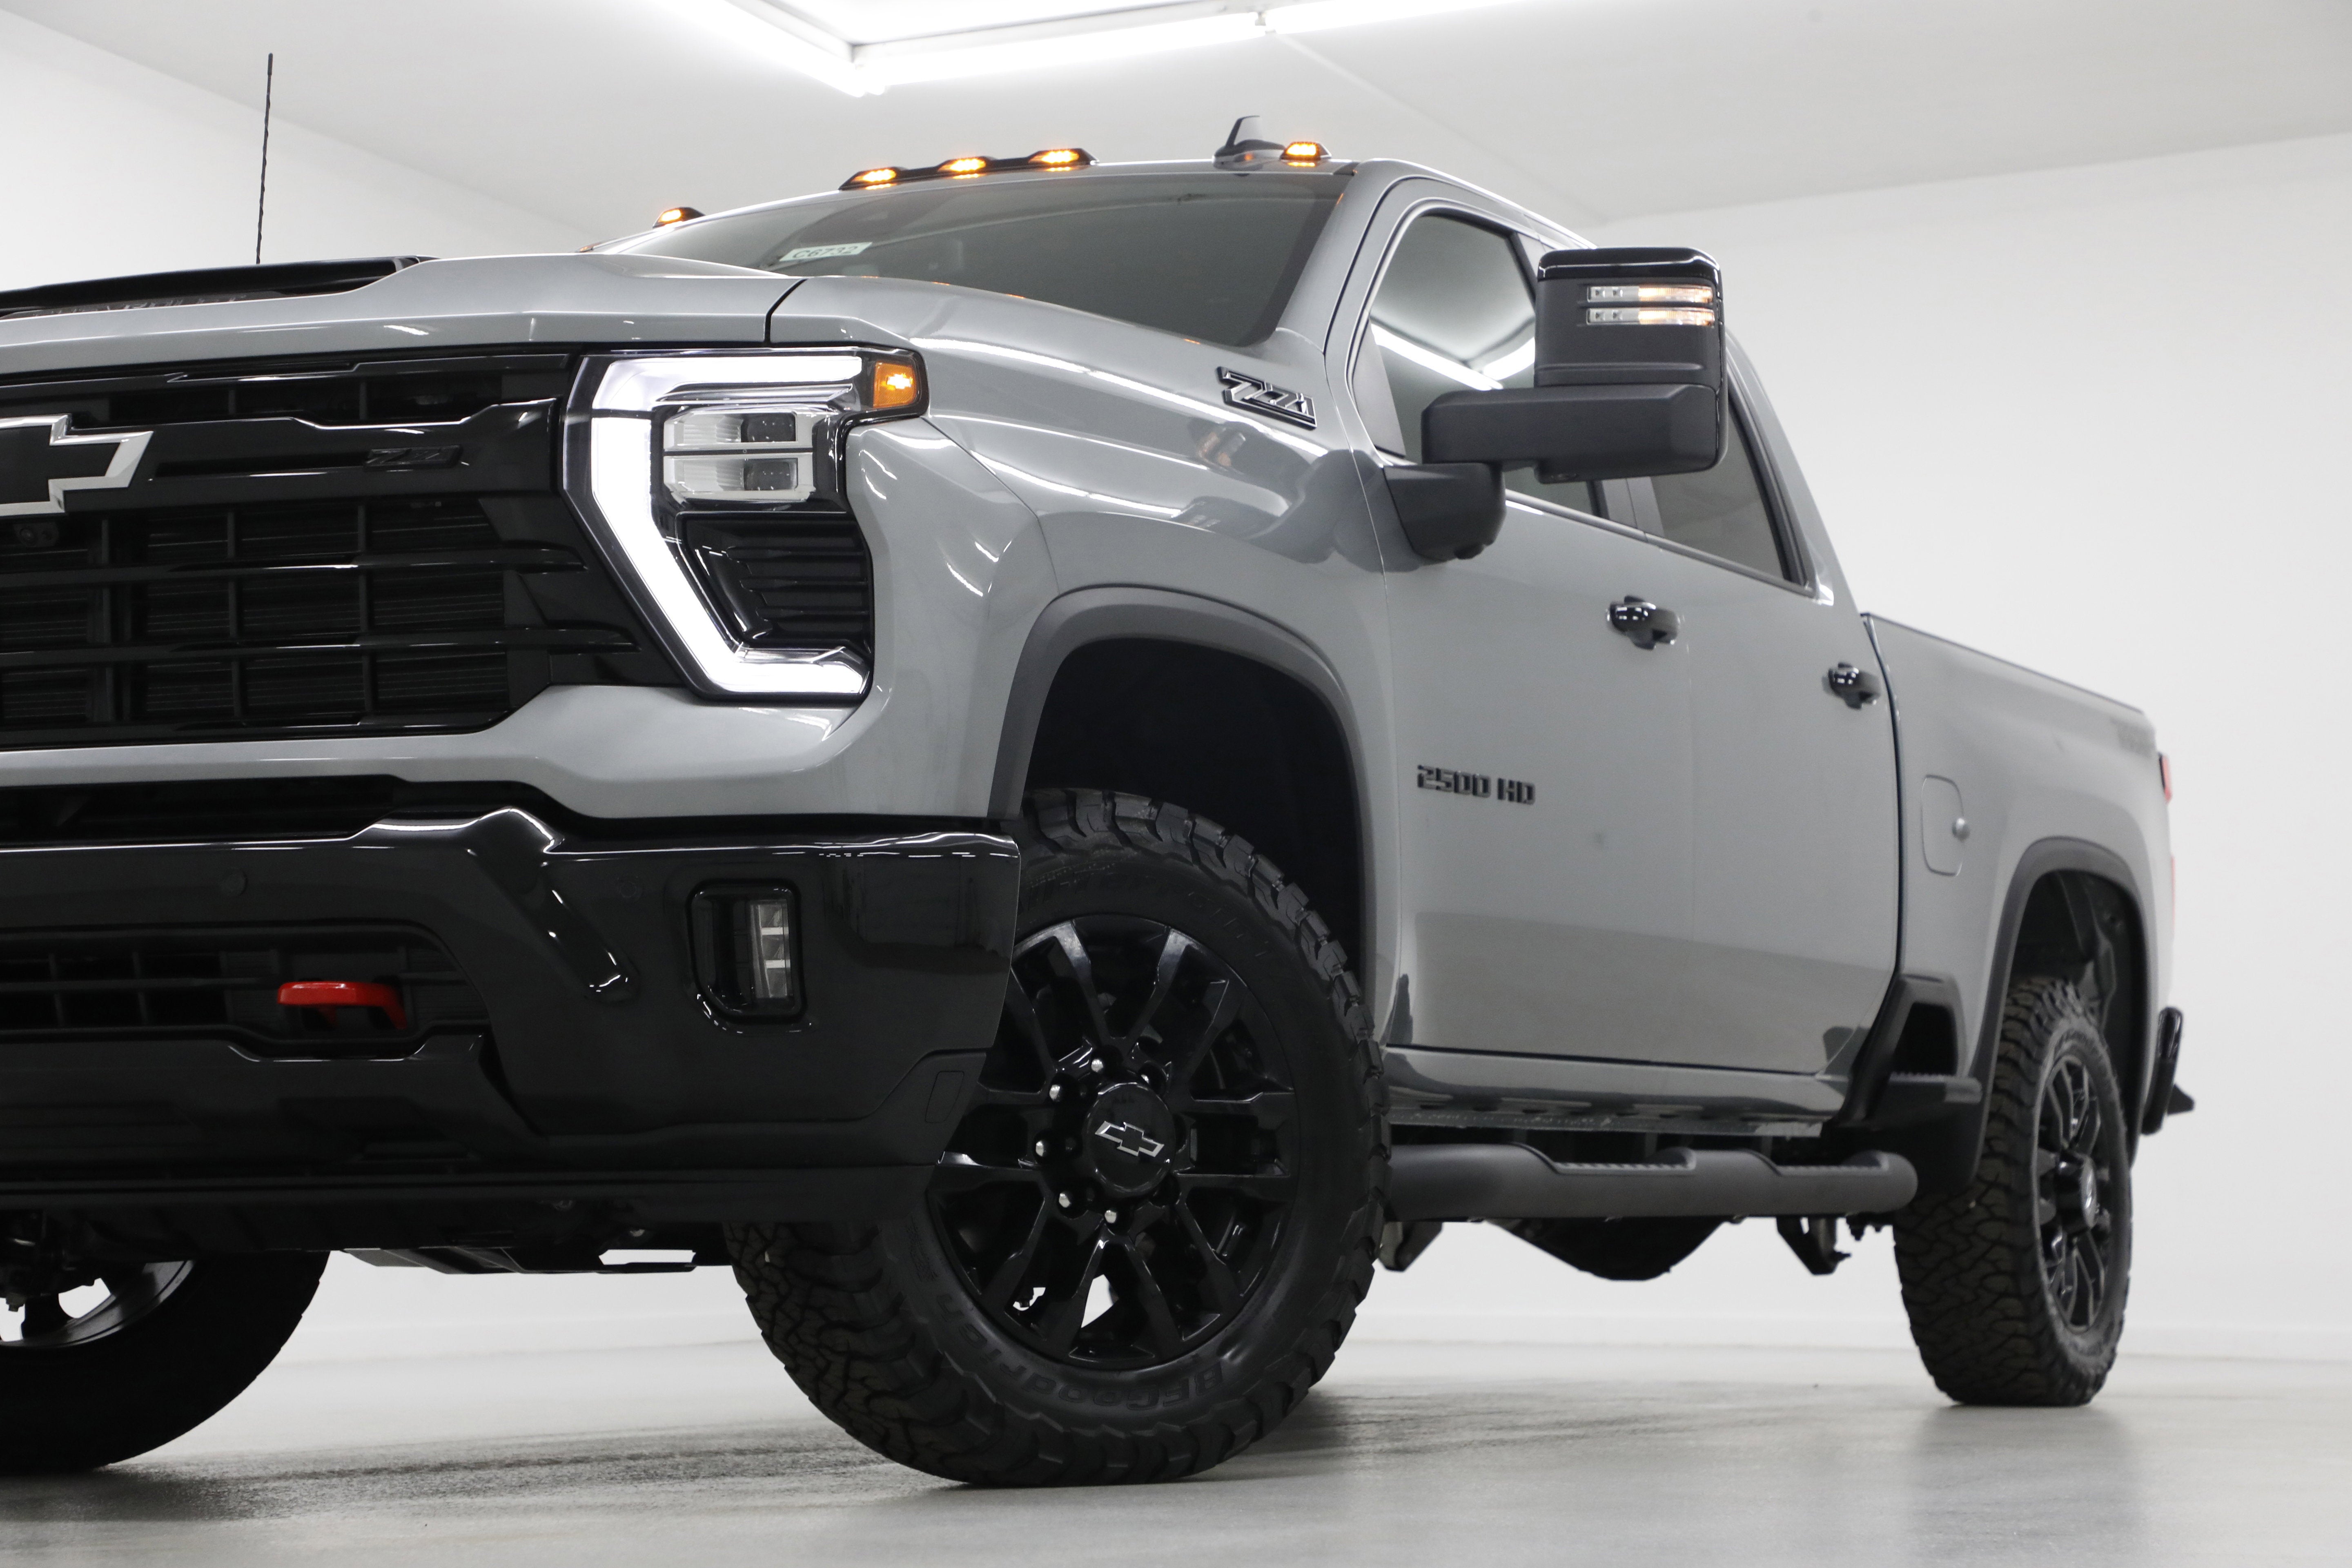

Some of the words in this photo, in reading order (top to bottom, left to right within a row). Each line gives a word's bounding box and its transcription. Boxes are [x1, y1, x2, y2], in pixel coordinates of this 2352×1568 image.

[792, 245, 859, 259] C6732
[1216, 366, 1317, 430] Z71
[1417, 764, 1491, 798] 2500
[1497, 777, 1536, 805] HD
